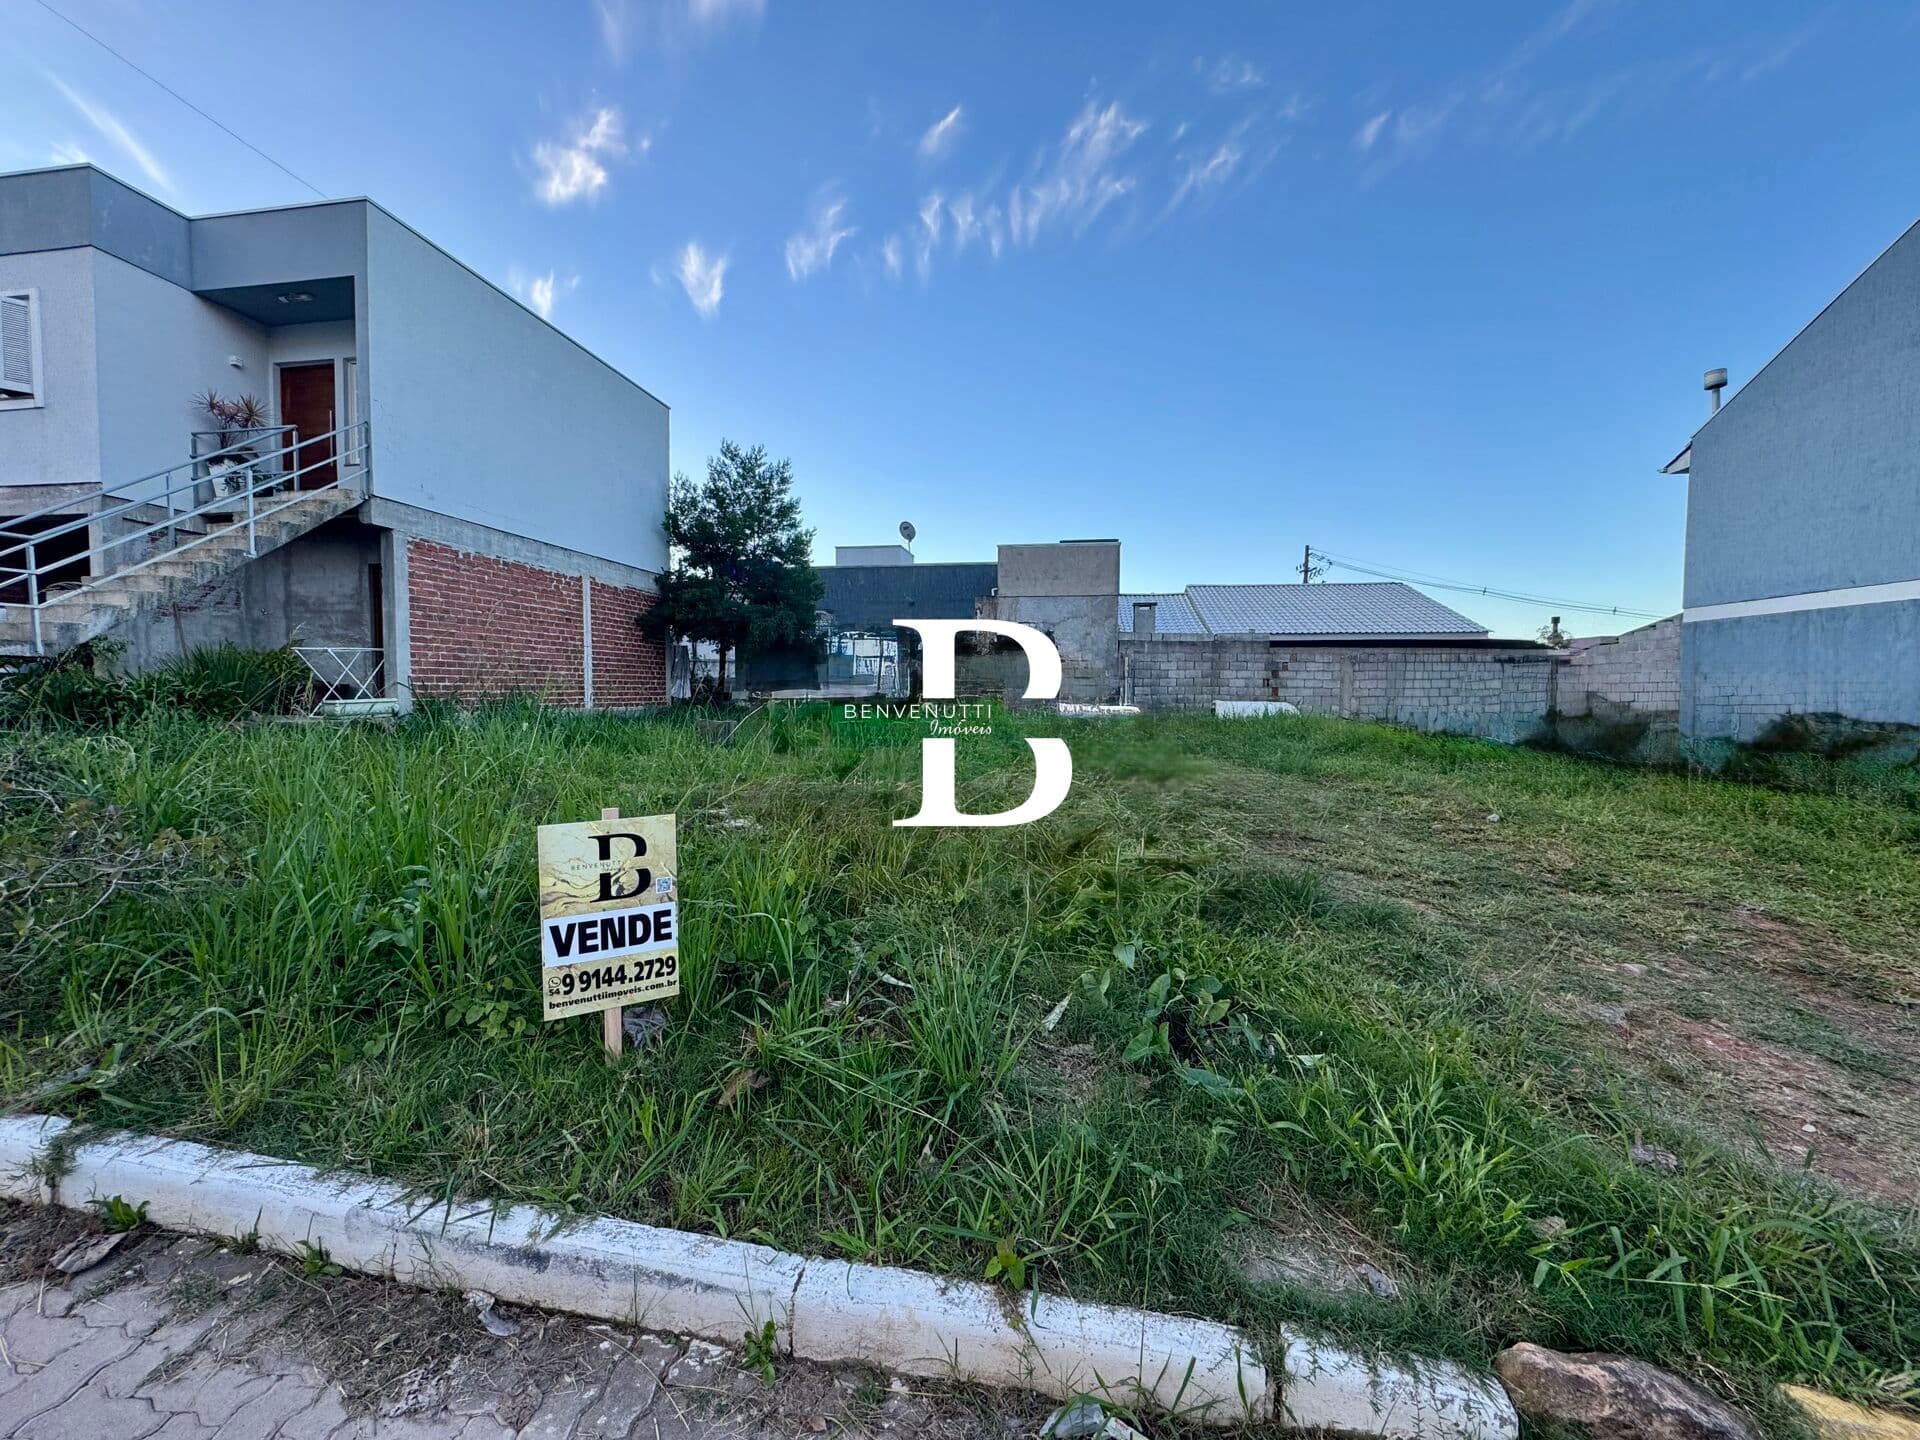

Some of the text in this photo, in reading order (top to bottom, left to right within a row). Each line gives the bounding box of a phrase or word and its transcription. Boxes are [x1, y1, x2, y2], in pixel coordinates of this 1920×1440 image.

[588, 833, 651, 903] B
[549, 909, 673, 958] VENDE
[549, 979, 677, 1009] benvenuttiimoveis.com.br
[561, 973, 575, 995] 9
[579, 955, 677, 992] 9144.2729
